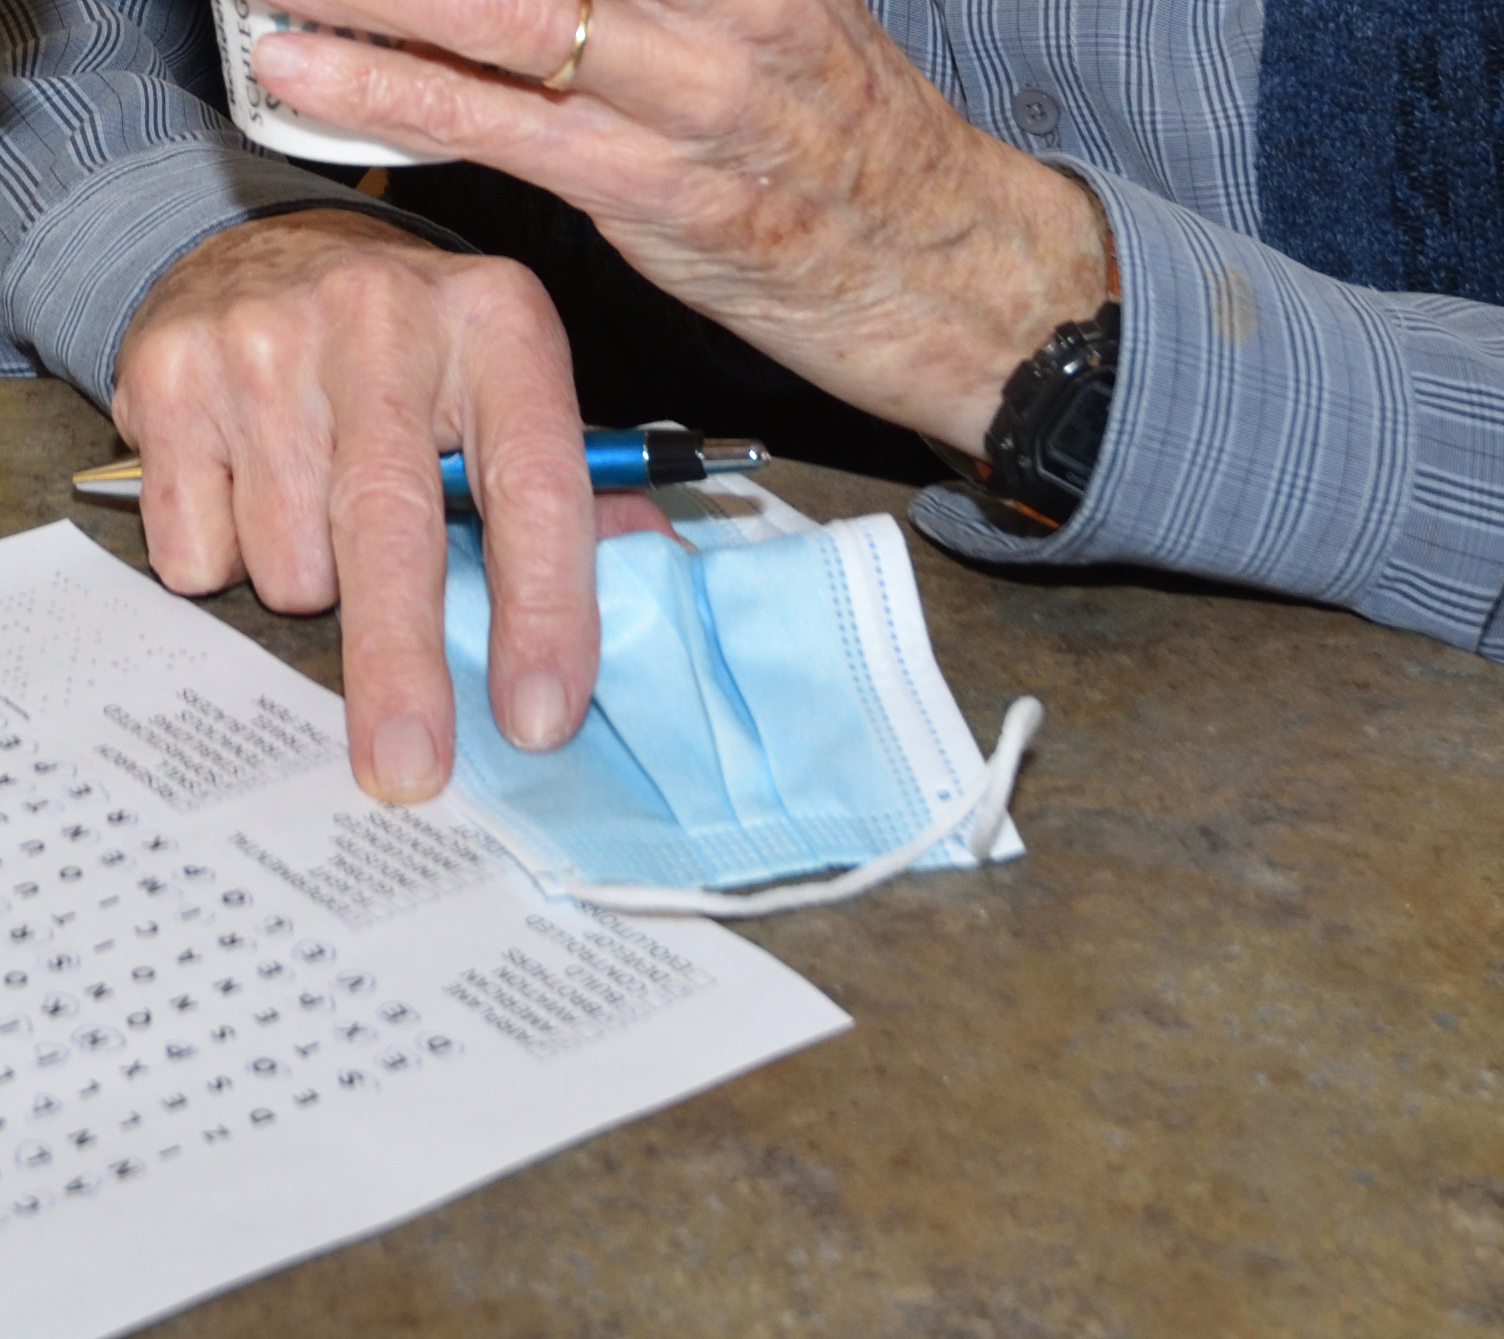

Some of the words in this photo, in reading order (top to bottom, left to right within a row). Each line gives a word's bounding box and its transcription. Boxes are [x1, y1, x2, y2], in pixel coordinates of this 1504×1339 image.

[502, 948, 602, 1014] BROTHERS
[525, 915, 646, 992] CONTROLLED
[583, 932, 670, 983] DEVELOP
[564, 964, 625, 1005] BUILD
